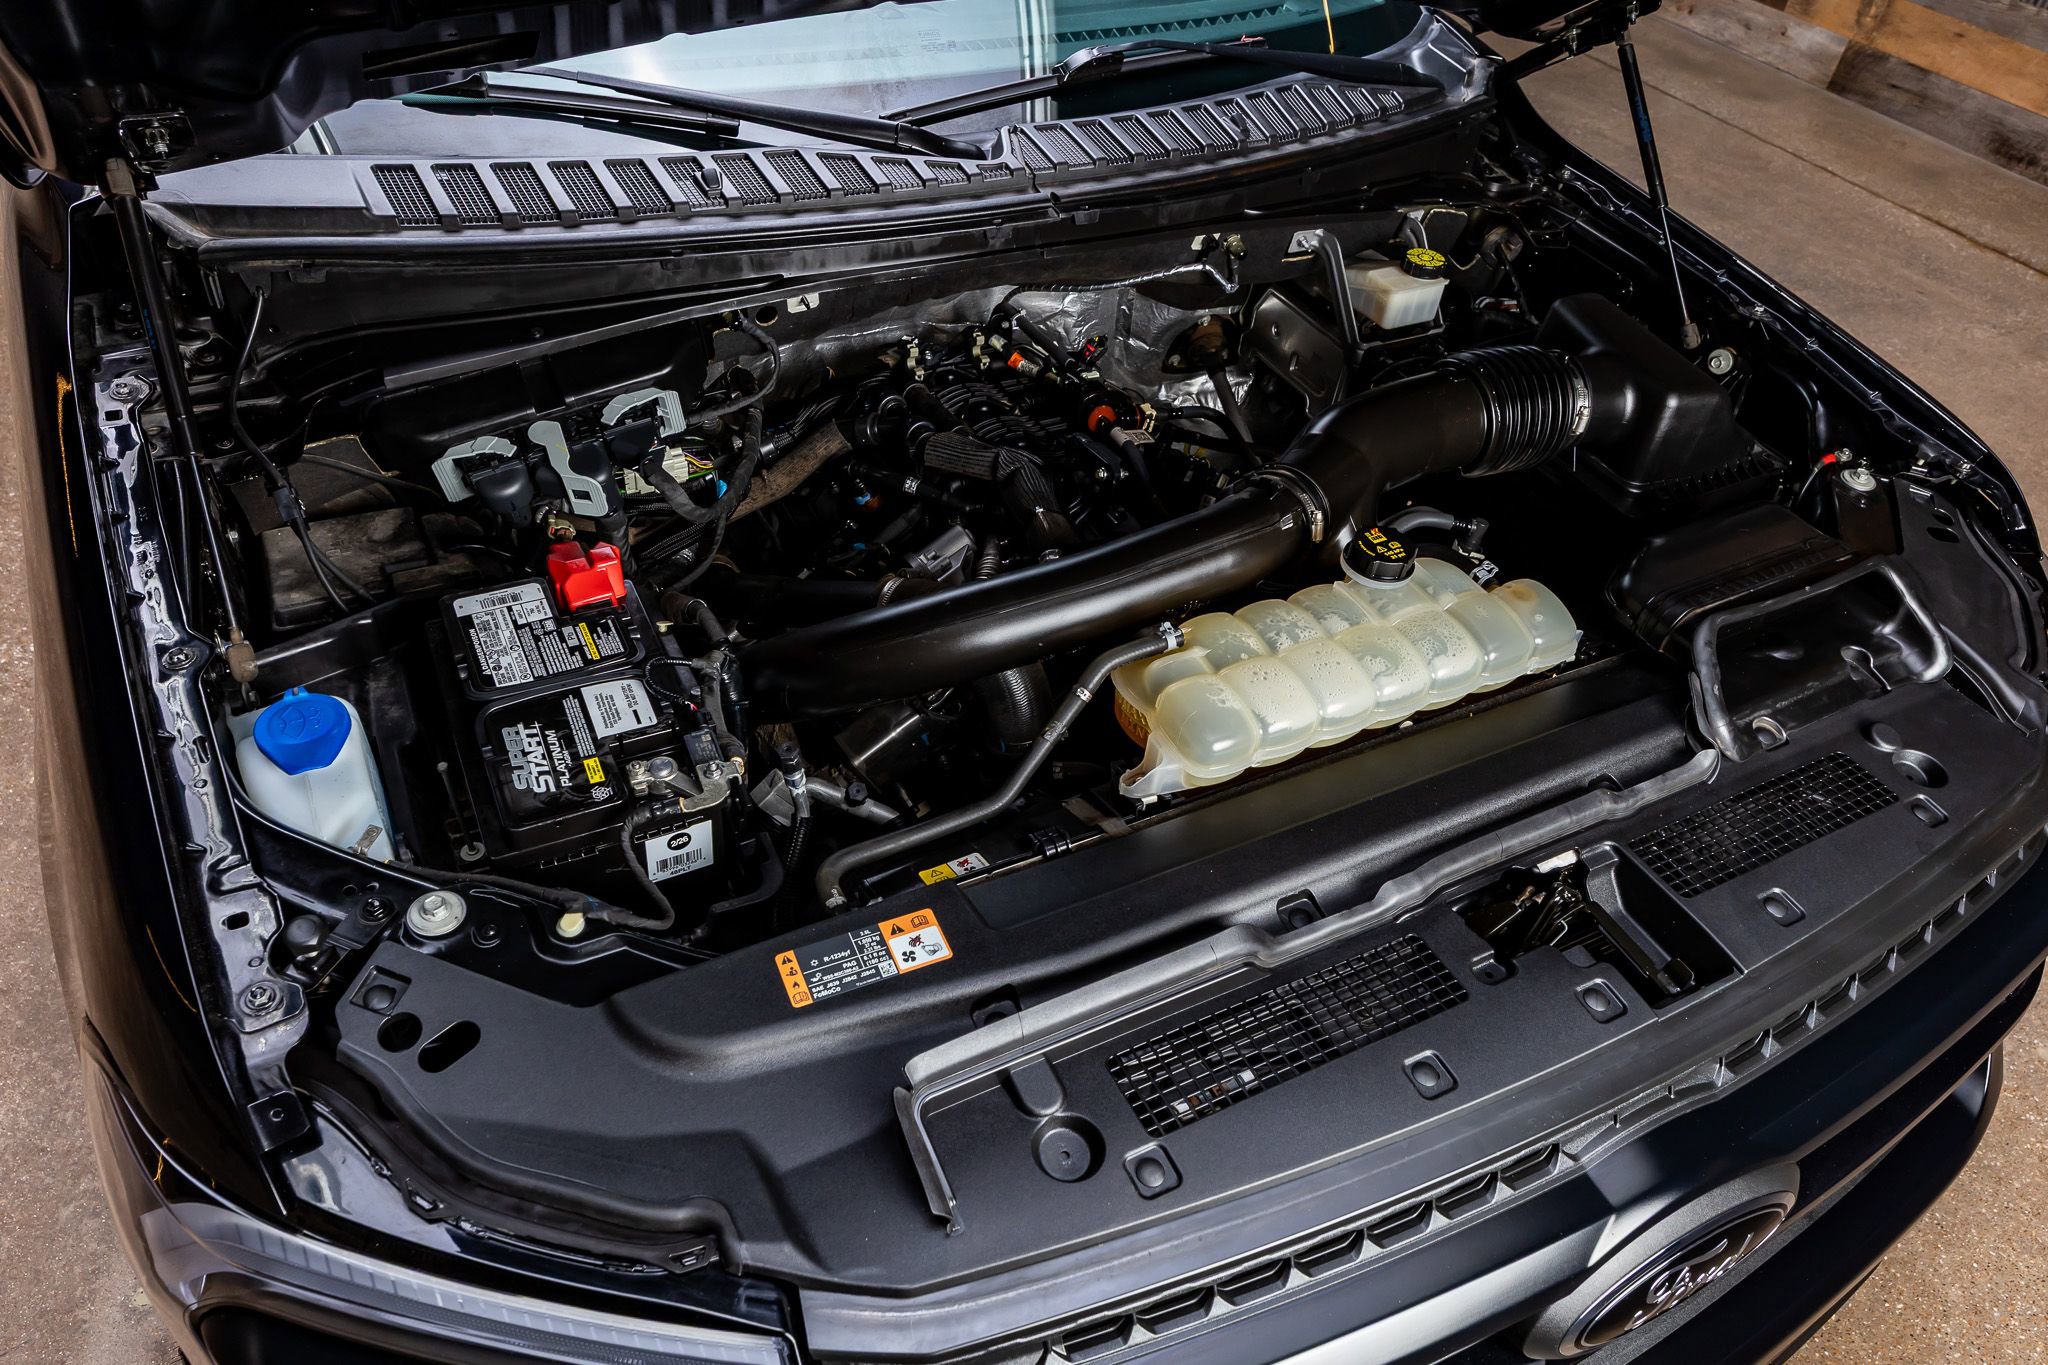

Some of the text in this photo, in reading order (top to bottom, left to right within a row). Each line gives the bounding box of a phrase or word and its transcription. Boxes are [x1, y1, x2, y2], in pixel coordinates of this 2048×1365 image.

[567, 632, 575, 640] Pb
[502, 727, 534, 790] SUPER
[517, 723, 556, 793] START
[545, 729, 572, 787] PLATINUM
[562, 750, 572, 765] AGM
[671, 836, 688, 847] 2/26
[824, 949, 851, 962] R-1234yf
[813, 987, 841, 999] FoMoCo
[1625, 1232, 1753, 1330] Ford
